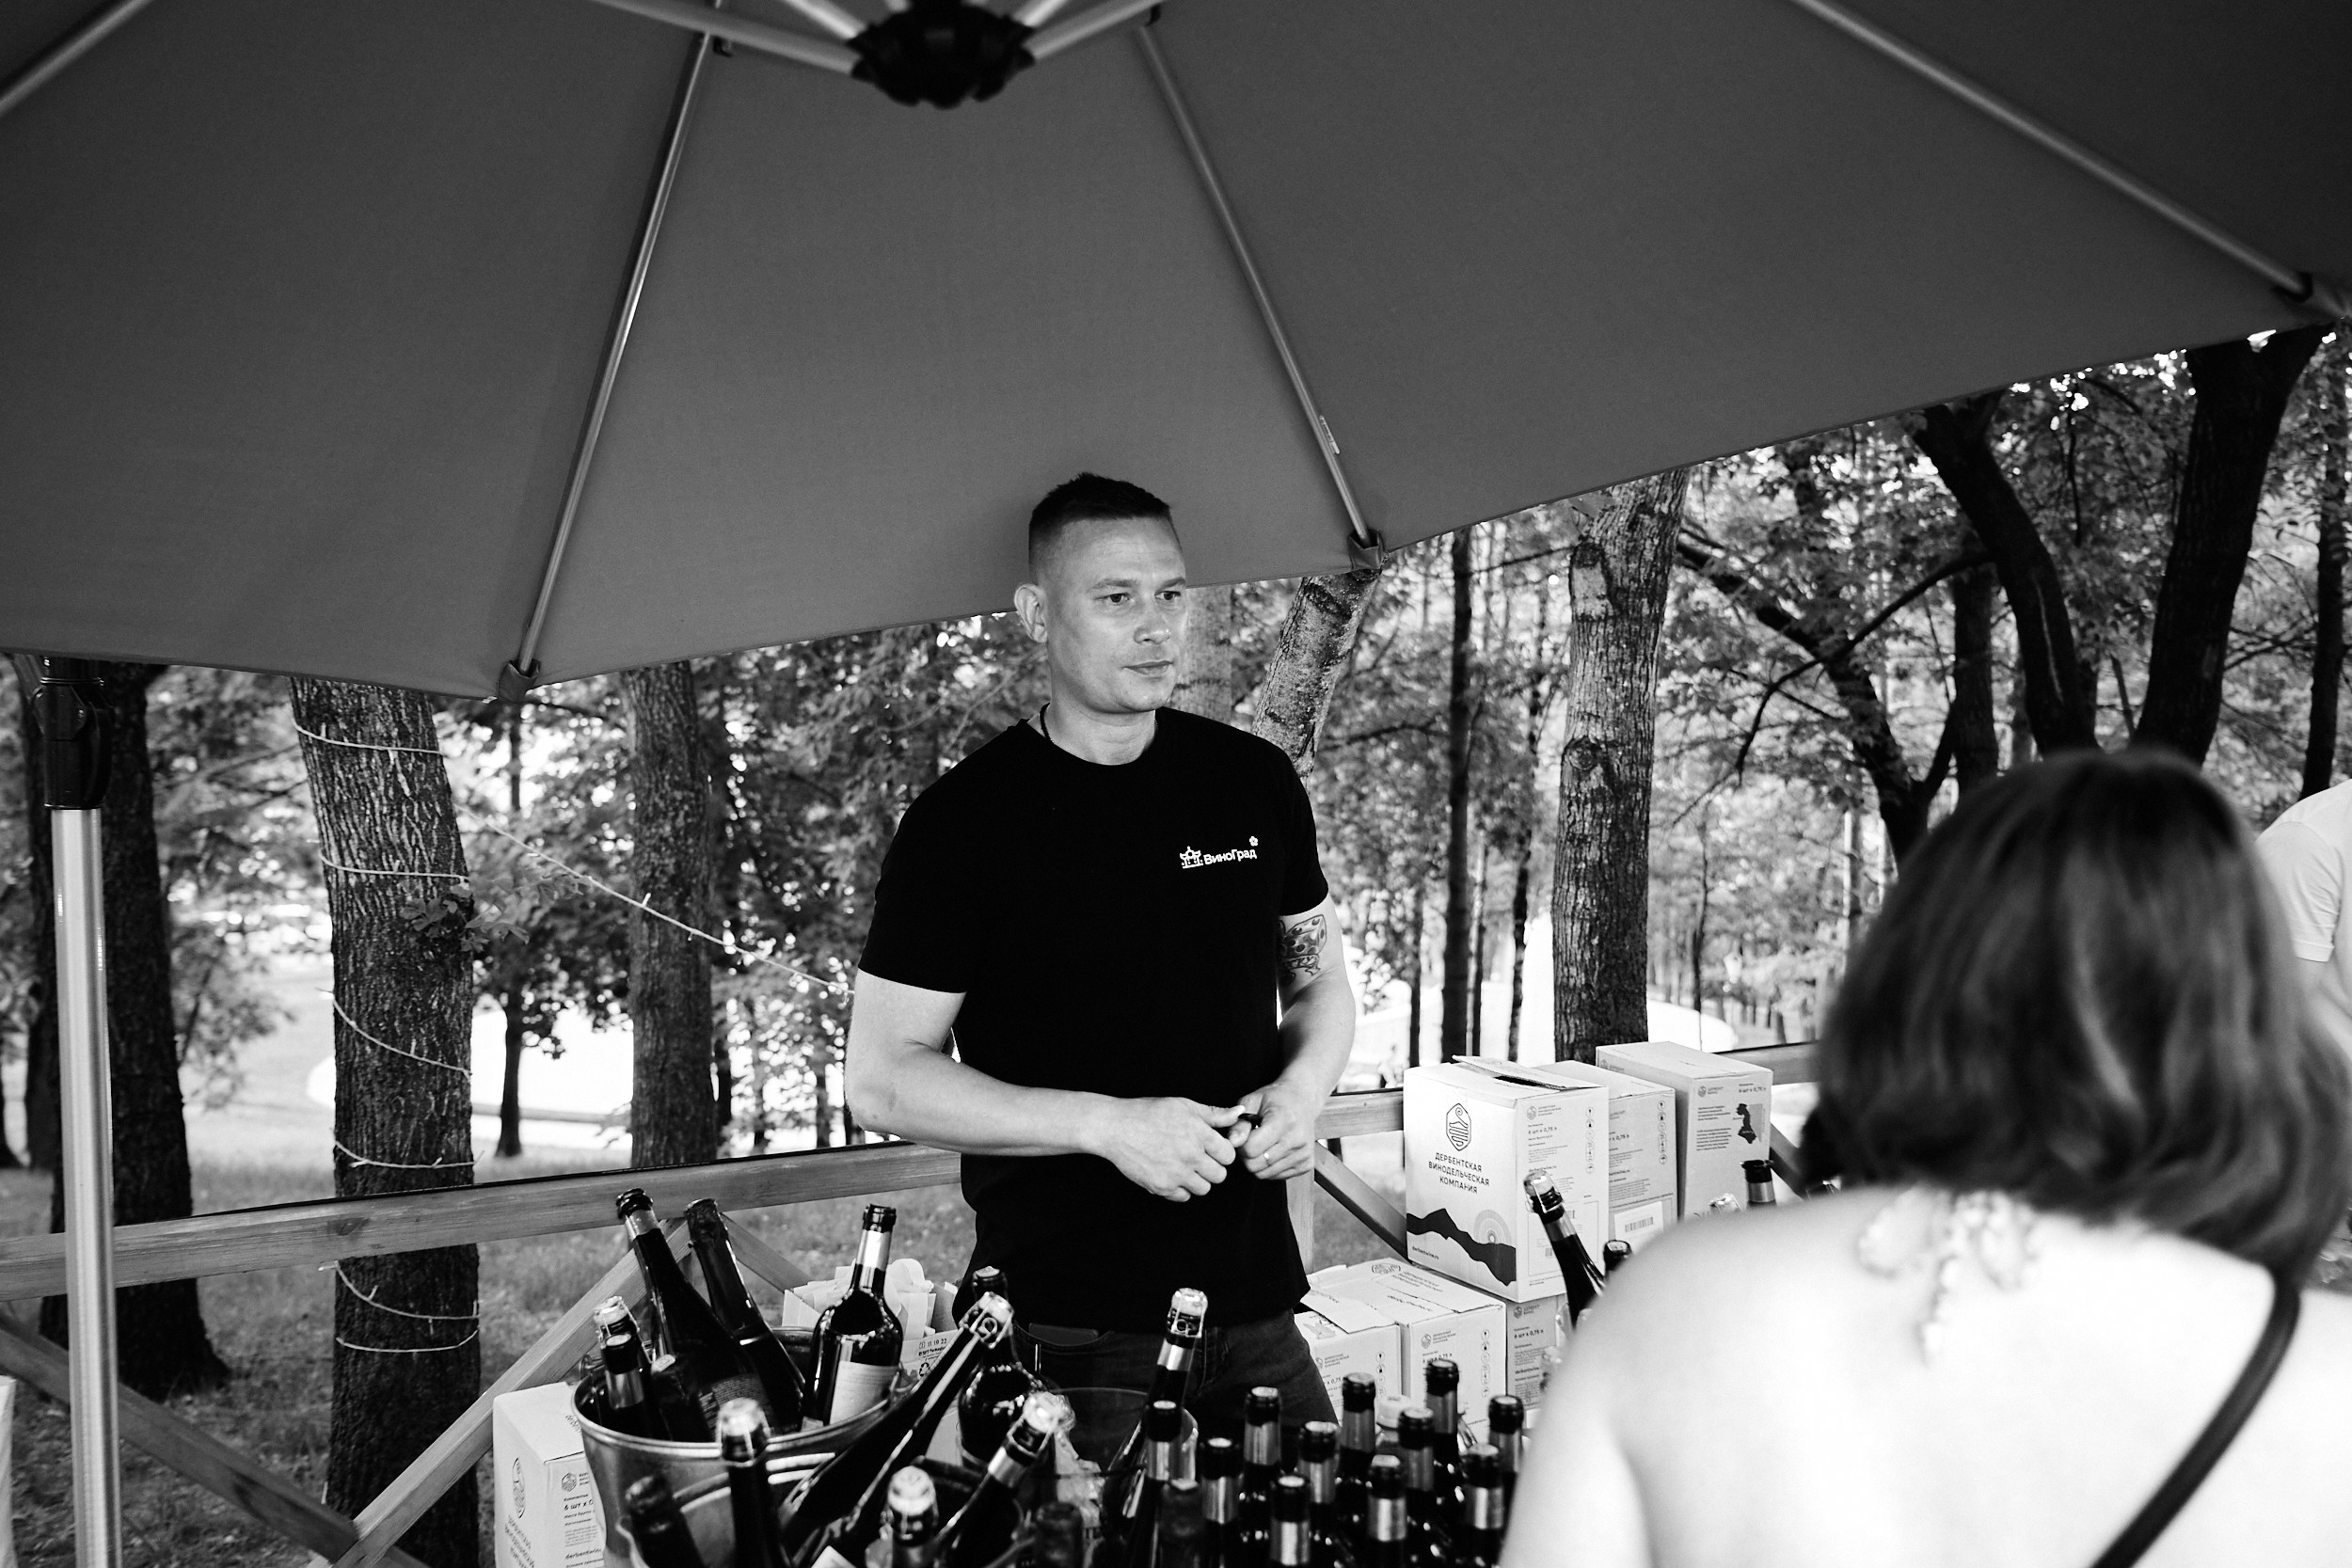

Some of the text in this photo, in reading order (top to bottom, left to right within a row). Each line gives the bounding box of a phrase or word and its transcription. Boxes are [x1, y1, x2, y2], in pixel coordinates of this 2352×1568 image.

[1203, 848, 1257, 865] ВиноГрад
[1435, 1152, 1482, 1173] ДЕРБЕНТСКАЯ
[1428, 1161, 1490, 1187] ВИНОДЕЛЬЧЕСКАЯ
[1439, 1176, 1478, 1194] КОМПАНИЯ
